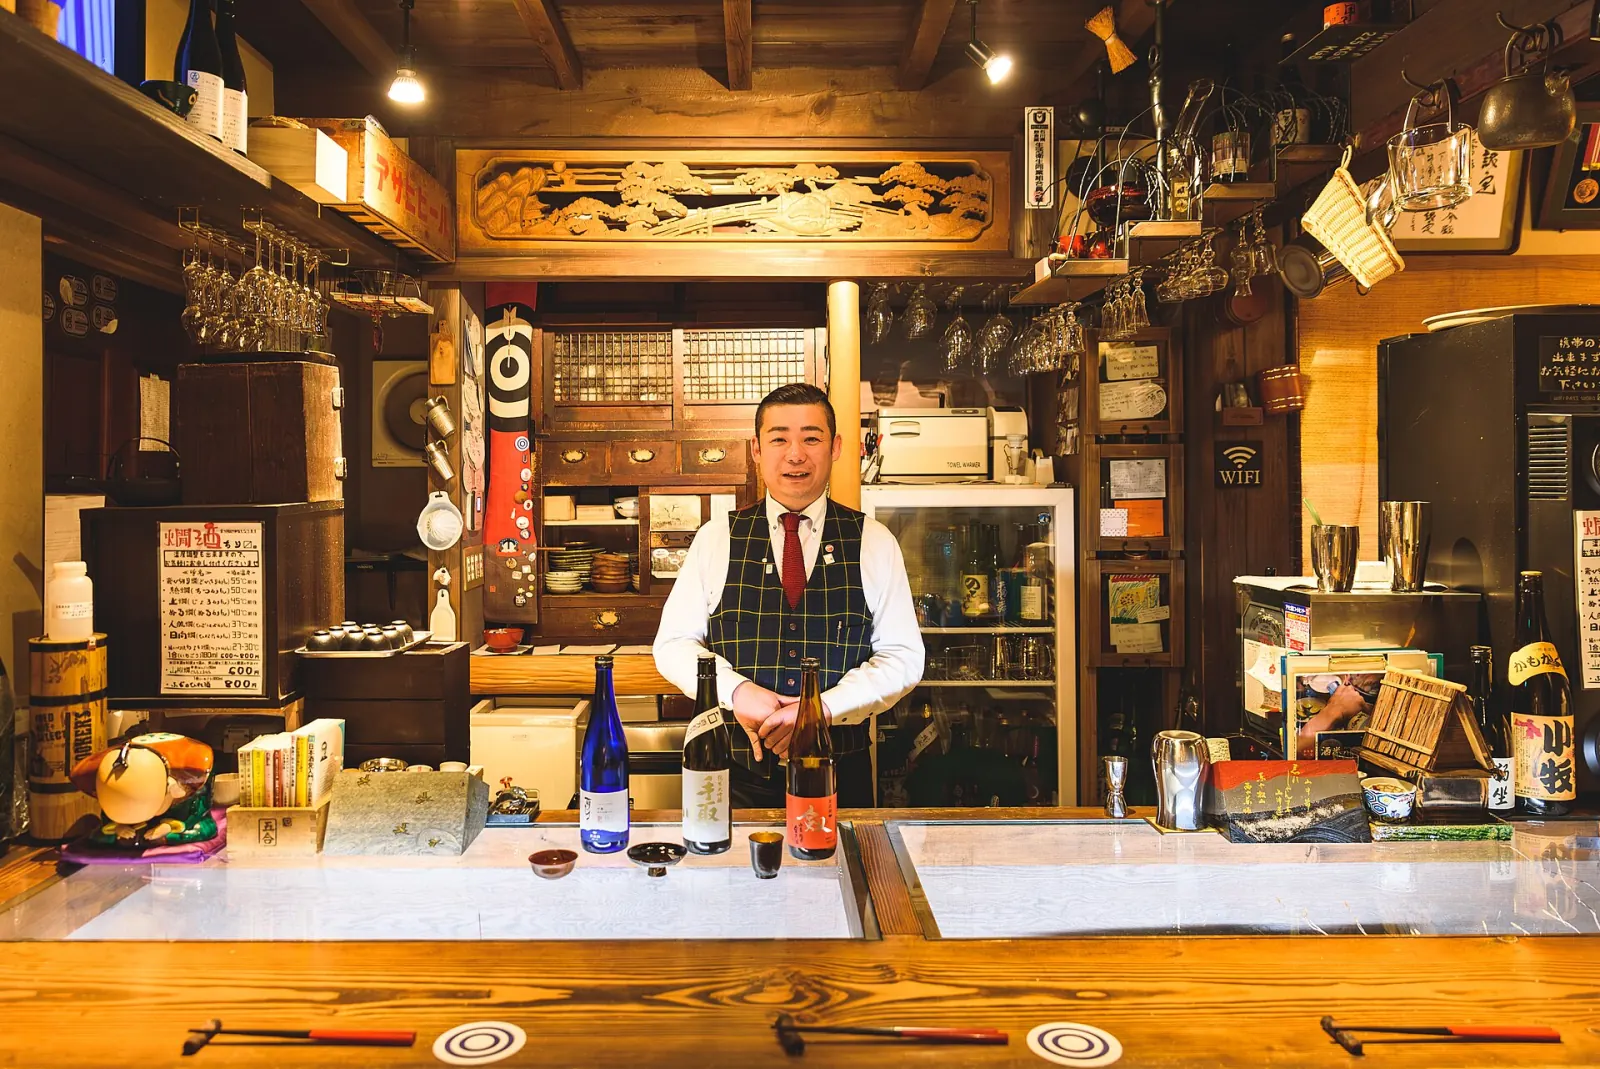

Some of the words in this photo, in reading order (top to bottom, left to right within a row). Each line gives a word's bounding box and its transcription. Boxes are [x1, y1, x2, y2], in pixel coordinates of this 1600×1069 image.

[1560, 337, 1600, 348] 携帯の
[1219, 470, 1260, 484] WIFI
[1540, 719, 1573, 795] 小牧
[263, 821, 275, 845] 五合
